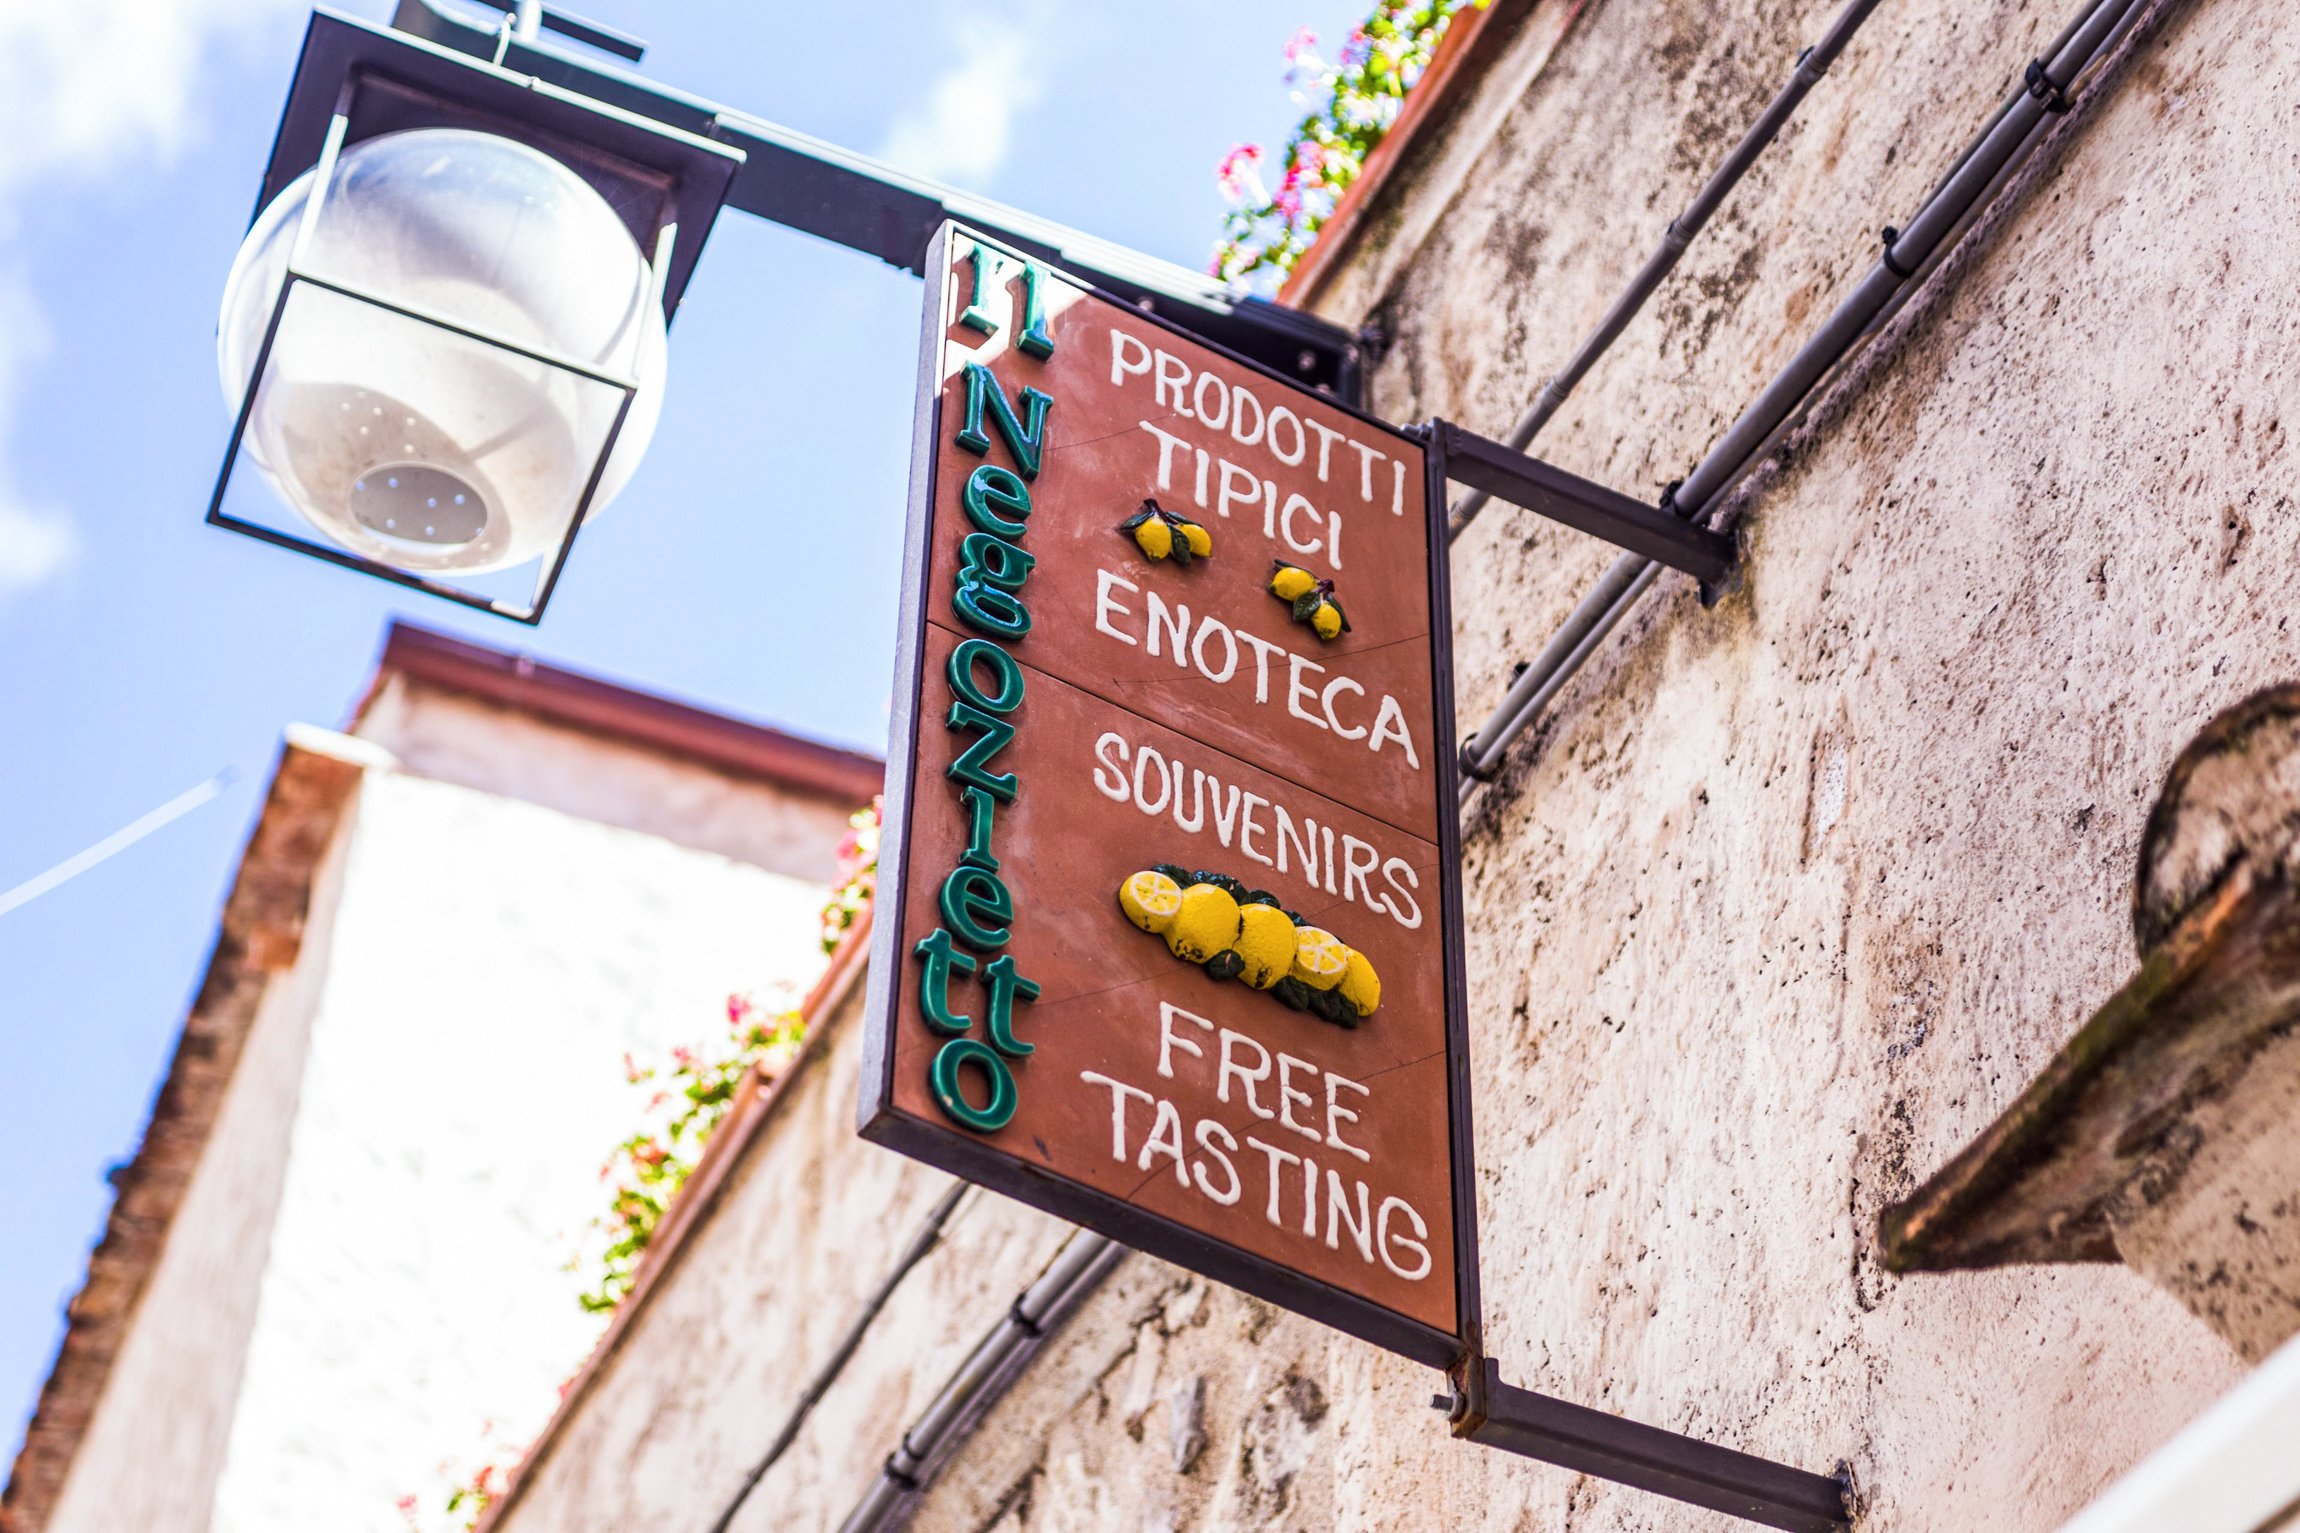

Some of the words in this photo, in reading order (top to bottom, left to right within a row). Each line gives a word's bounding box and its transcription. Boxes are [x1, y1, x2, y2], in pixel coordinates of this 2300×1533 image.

[1109, 328, 1406, 517] PRODOTTI
[1139, 421, 1342, 570] TIPICI
[913, 360, 1054, 1133] Negozietto
[1095, 567, 1420, 771] ENOTECA
[1093, 732, 1423, 930] SOUVENIRS
[1080, 1070, 1433, 1281] TASTING
[1158, 1001, 1371, 1163] FREE
